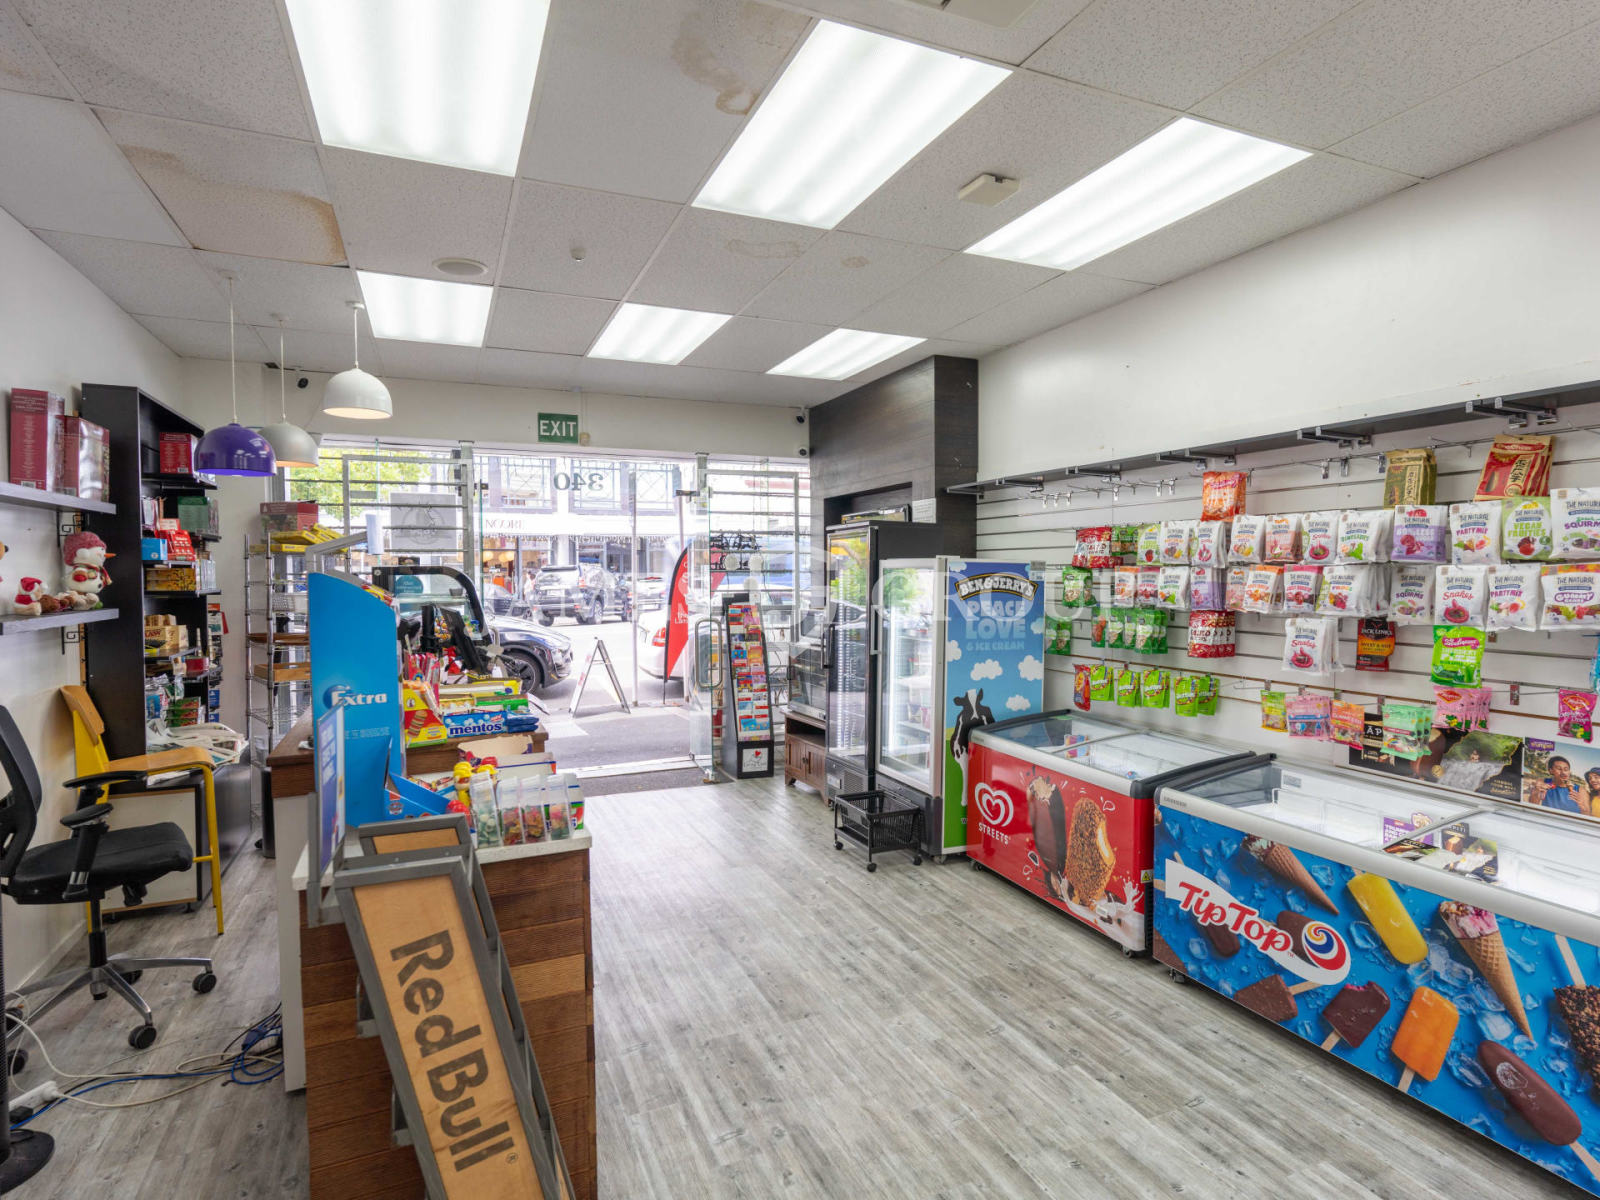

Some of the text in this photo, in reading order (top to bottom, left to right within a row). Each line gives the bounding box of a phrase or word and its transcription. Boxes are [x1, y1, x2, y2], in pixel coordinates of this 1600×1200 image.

[540, 420, 577, 437] EXIT
[1564, 520, 1600, 530] SQUIRM
[1508, 528, 1547, 537] FRUITIES
[1503, 575, 1525, 583] NATURAL
[1557, 575, 1595, 584] THE NATURAL
[1442, 590, 1475, 601] Snakes
[1490, 590, 1508, 598] PARTY
[966, 600, 1025, 617] PEACE
[966, 618, 1026, 639] LOVE
[980, 641, 996, 651] ICE
[996, 641, 1025, 651] CREAM
[331, 690, 387, 706] Extra
[449, 722, 503, 736] mentos
[978, 822, 1009, 845] STREETS
